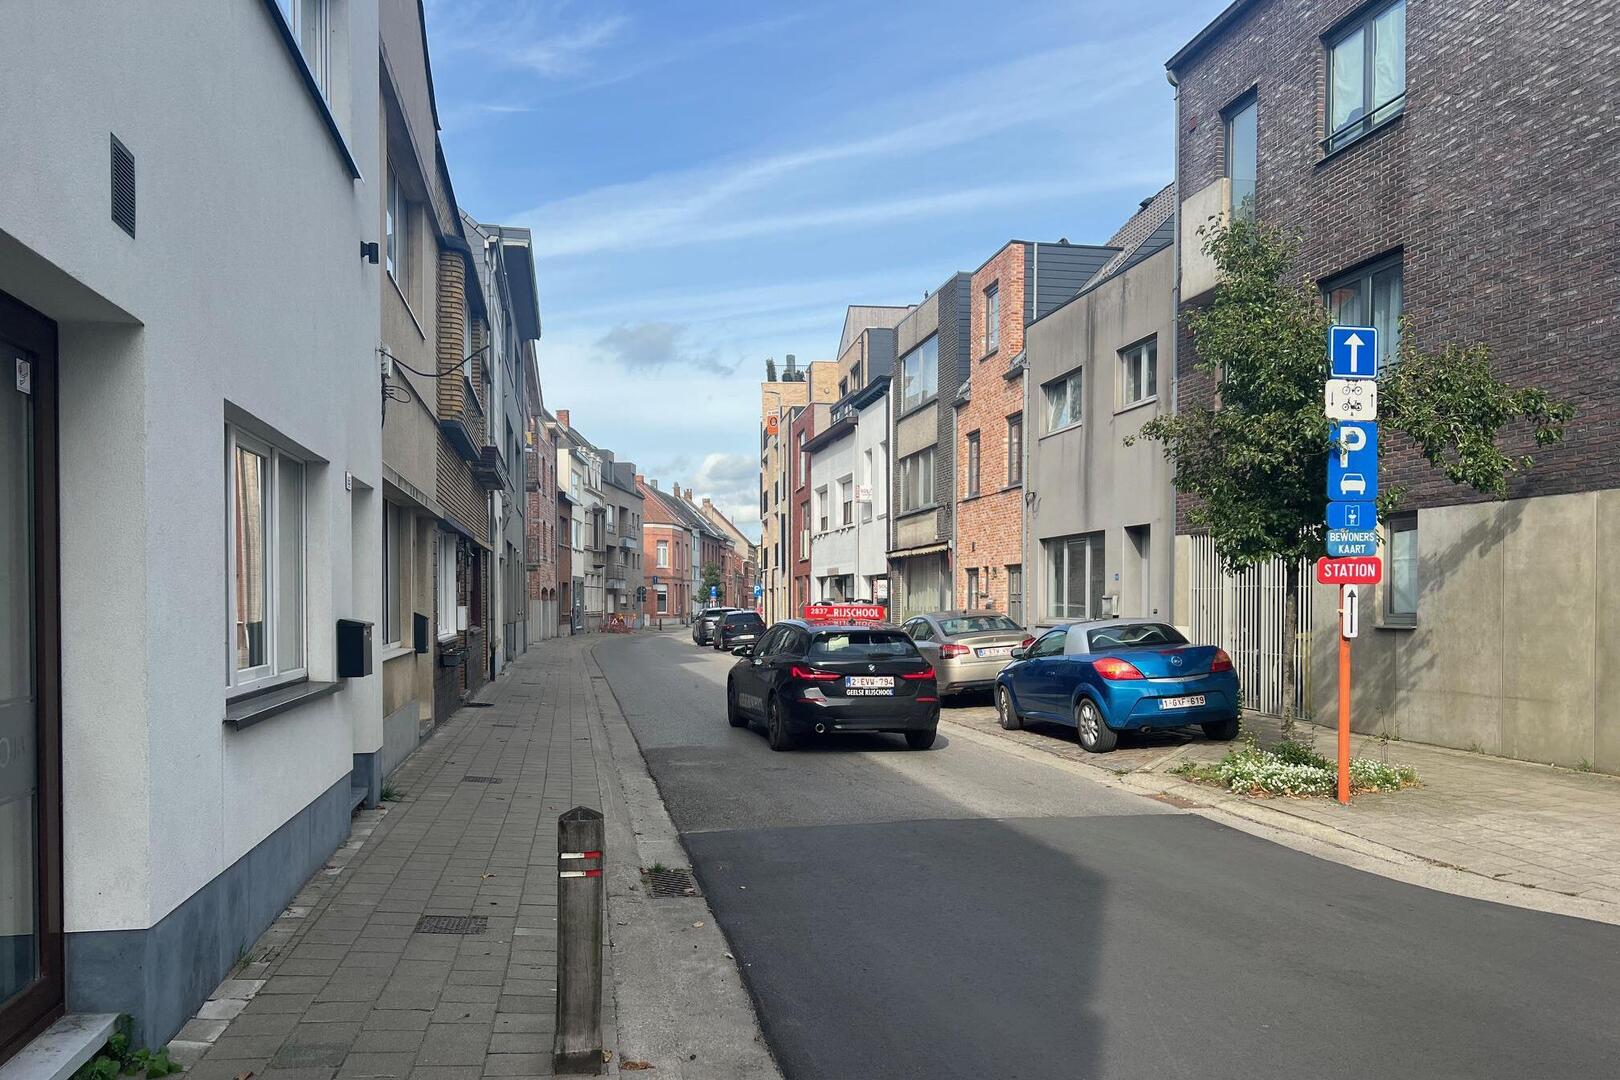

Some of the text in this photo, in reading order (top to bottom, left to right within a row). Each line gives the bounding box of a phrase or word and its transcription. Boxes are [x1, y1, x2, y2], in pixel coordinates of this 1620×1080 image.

[1340, 426, 1367, 468] P
[1330, 532, 1375, 542] BEWONERS
[1338, 544, 1366, 554] KAART
[1324, 563, 1376, 577] STATION
[754, 585, 761, 594] P
[833, 608, 879, 617] RIJSCHOOL
[1164, 696, 1205, 708] 1-GXF-619
